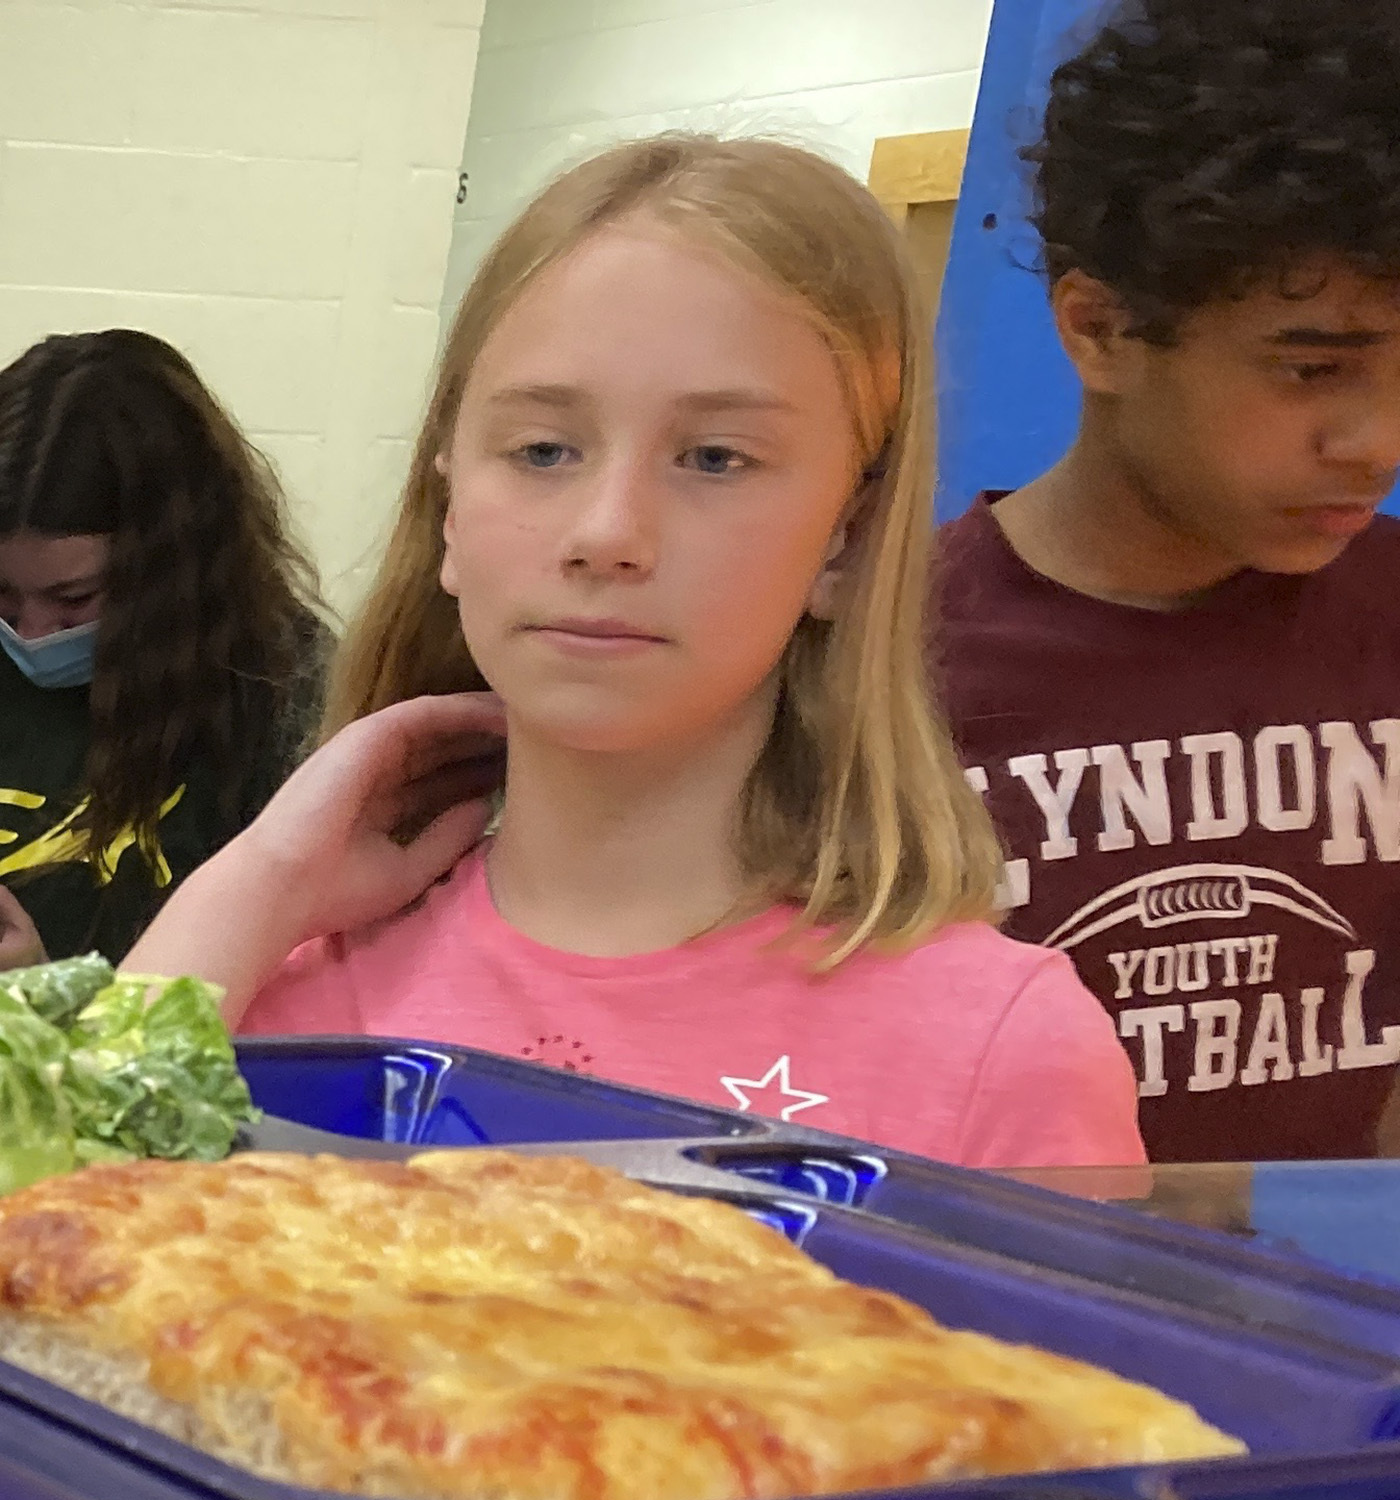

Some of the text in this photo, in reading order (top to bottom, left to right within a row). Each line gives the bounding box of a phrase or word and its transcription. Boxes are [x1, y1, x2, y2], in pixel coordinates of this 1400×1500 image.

[964, 718, 1400, 910] YNDON
[1106, 934, 1279, 999] YOUTH
[1120, 949, 1400, 1098] TBALL
